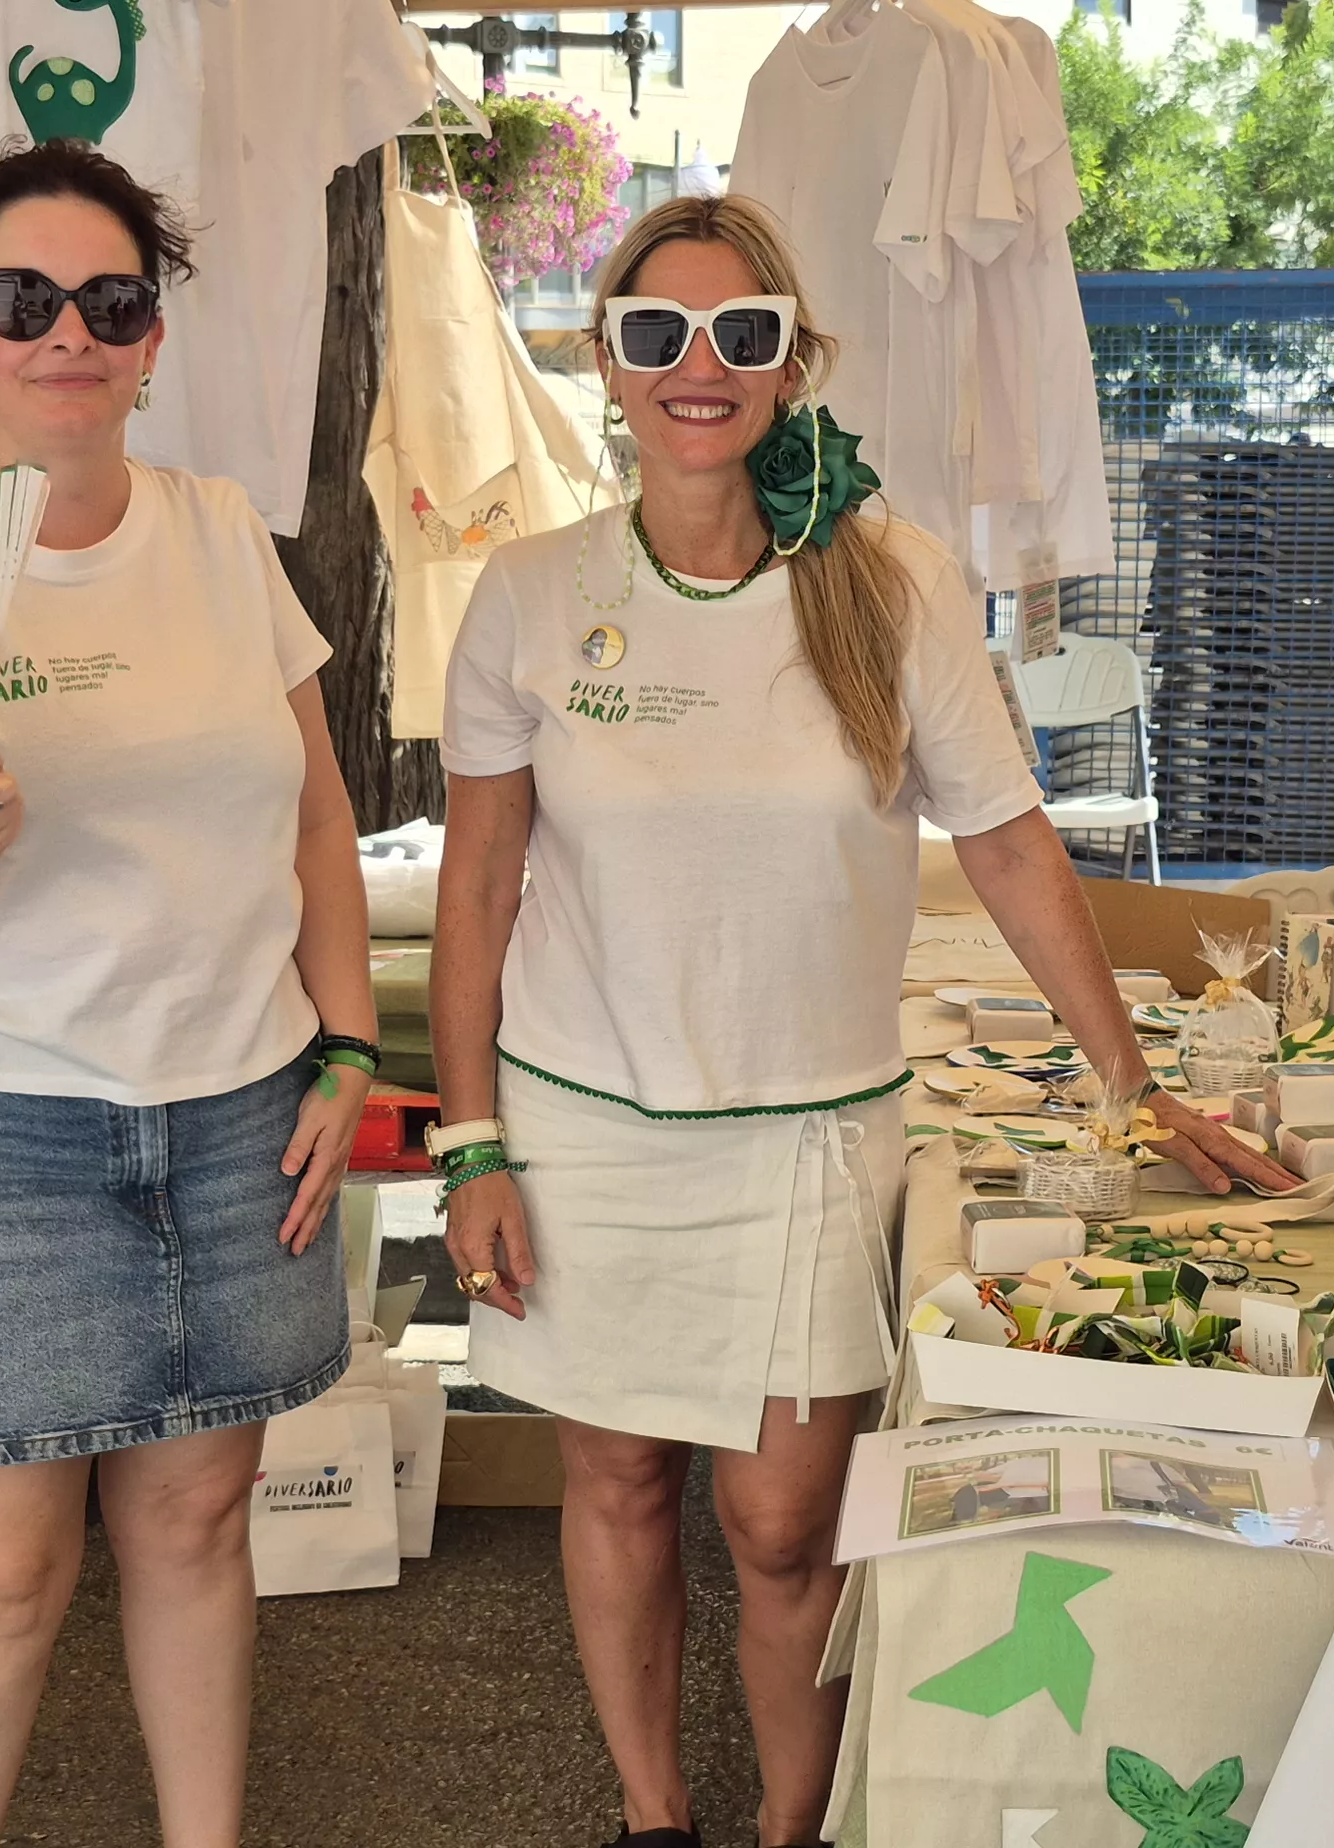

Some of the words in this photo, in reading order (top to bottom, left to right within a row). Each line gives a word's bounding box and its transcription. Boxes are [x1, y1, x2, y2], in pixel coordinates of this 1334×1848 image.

[65, 656, 80, 665] hay
[82, 652, 117, 663] cuerpos
[0, 655, 37, 677] VER
[78, 664, 89, 672] de
[92, 671, 108, 680] mal
[59, 682, 103, 693] pensados
[570, 679, 625, 703] DIVER
[639, 685, 651, 693] No
[653, 684, 668, 693] hay
[670, 686, 706, 697] cuerpos
[638, 695, 660, 703] fuera
[662, 695, 672, 703] de
[700, 700, 719, 708] sino
[566, 697, 630, 723] SARIO
[636, 705, 668, 715] lugares
[670, 707, 687, 716] mal
[634, 715, 677, 725] pensados
[904, 1425, 1207, 1450] PORTA-CHAQUETAS
[265, 1477, 353, 1498] DIVERSARIO
